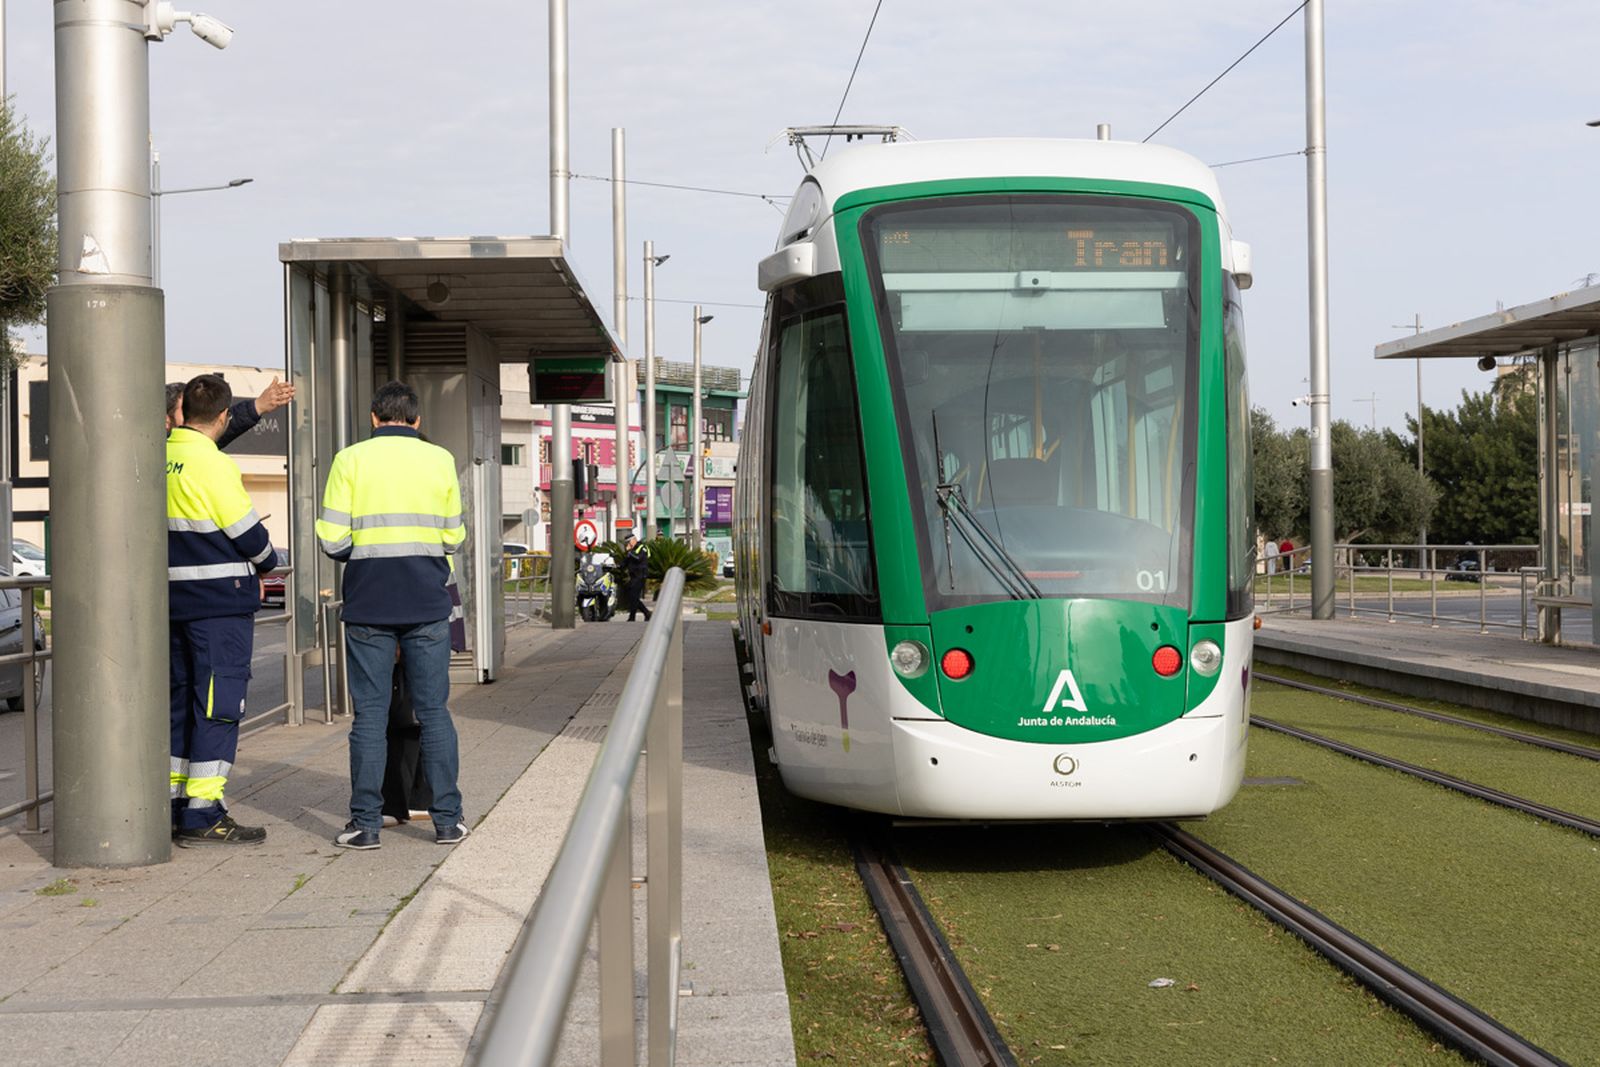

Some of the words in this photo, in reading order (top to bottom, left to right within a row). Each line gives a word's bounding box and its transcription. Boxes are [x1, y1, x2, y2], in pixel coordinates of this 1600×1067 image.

[1067, 231, 1167, 266] Tran
[1136, 570, 1165, 590] 01
[1017, 717, 1047, 726] Junta
[1050, 716, 1063, 726] de
[1065, 715, 1116, 726] Andalucía
